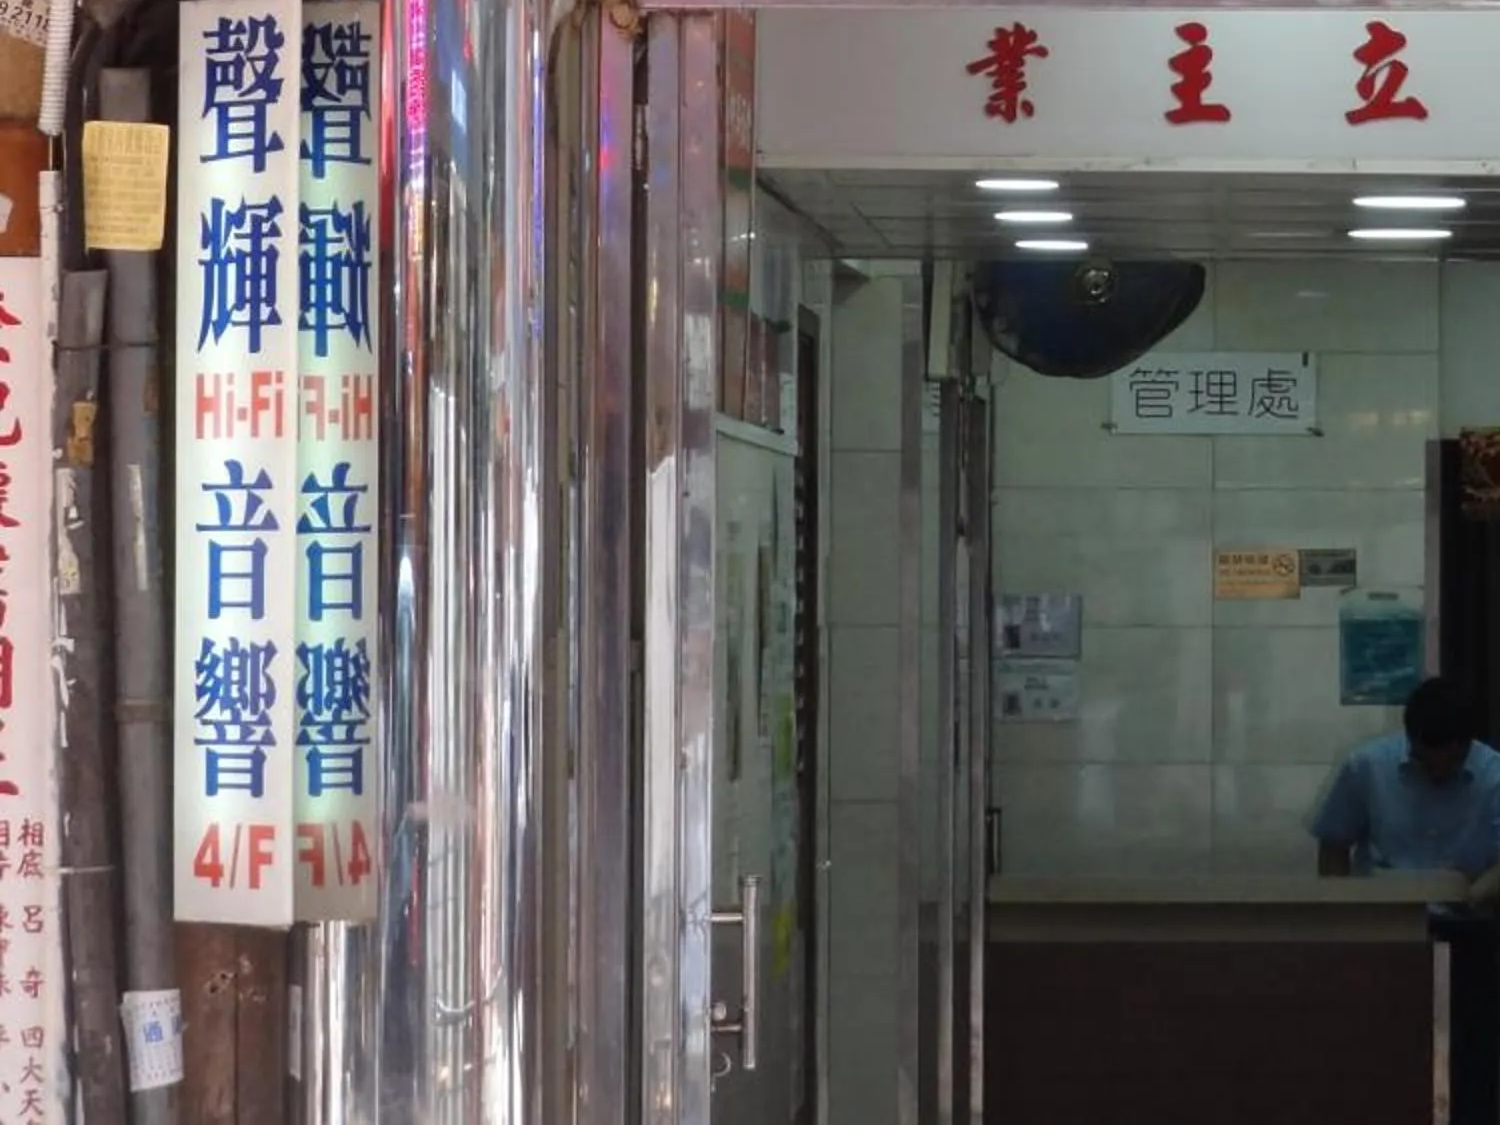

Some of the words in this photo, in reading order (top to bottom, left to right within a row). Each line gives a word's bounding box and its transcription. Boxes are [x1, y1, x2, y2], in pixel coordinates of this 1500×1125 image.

[196, 371, 284, 439] Hi-Fi
[1129, 367, 1300, 420] 管理處
[193, 458, 280, 799] 音響
[193, 823, 276, 890] 4/F
